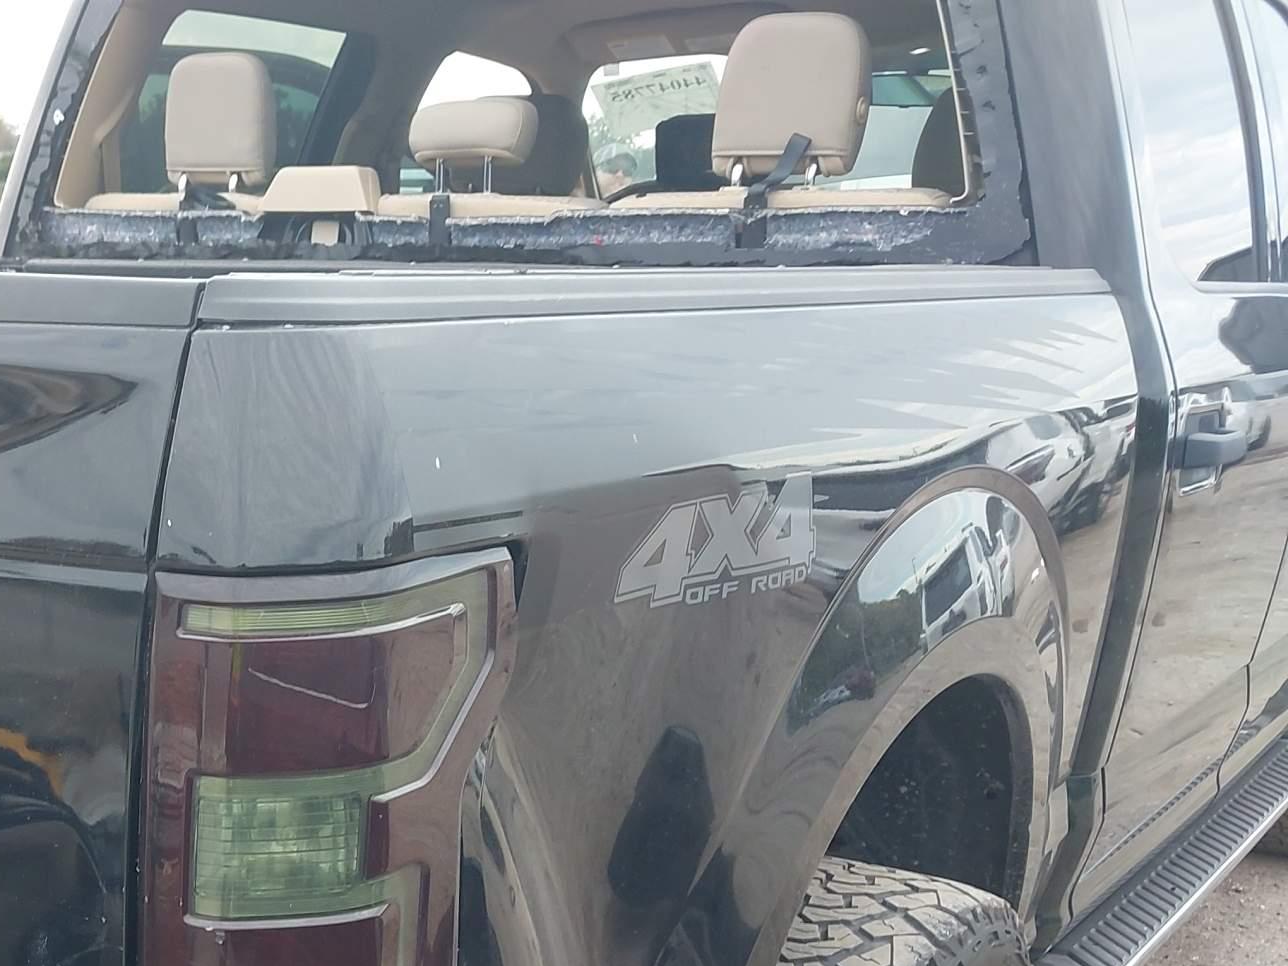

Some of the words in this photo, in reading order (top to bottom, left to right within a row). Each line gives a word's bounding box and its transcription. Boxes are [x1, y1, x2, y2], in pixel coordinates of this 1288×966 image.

[614, 470, 816, 608] 4X4
[684, 580, 740, 605] OFF
[750, 566, 809, 594] ROAD
